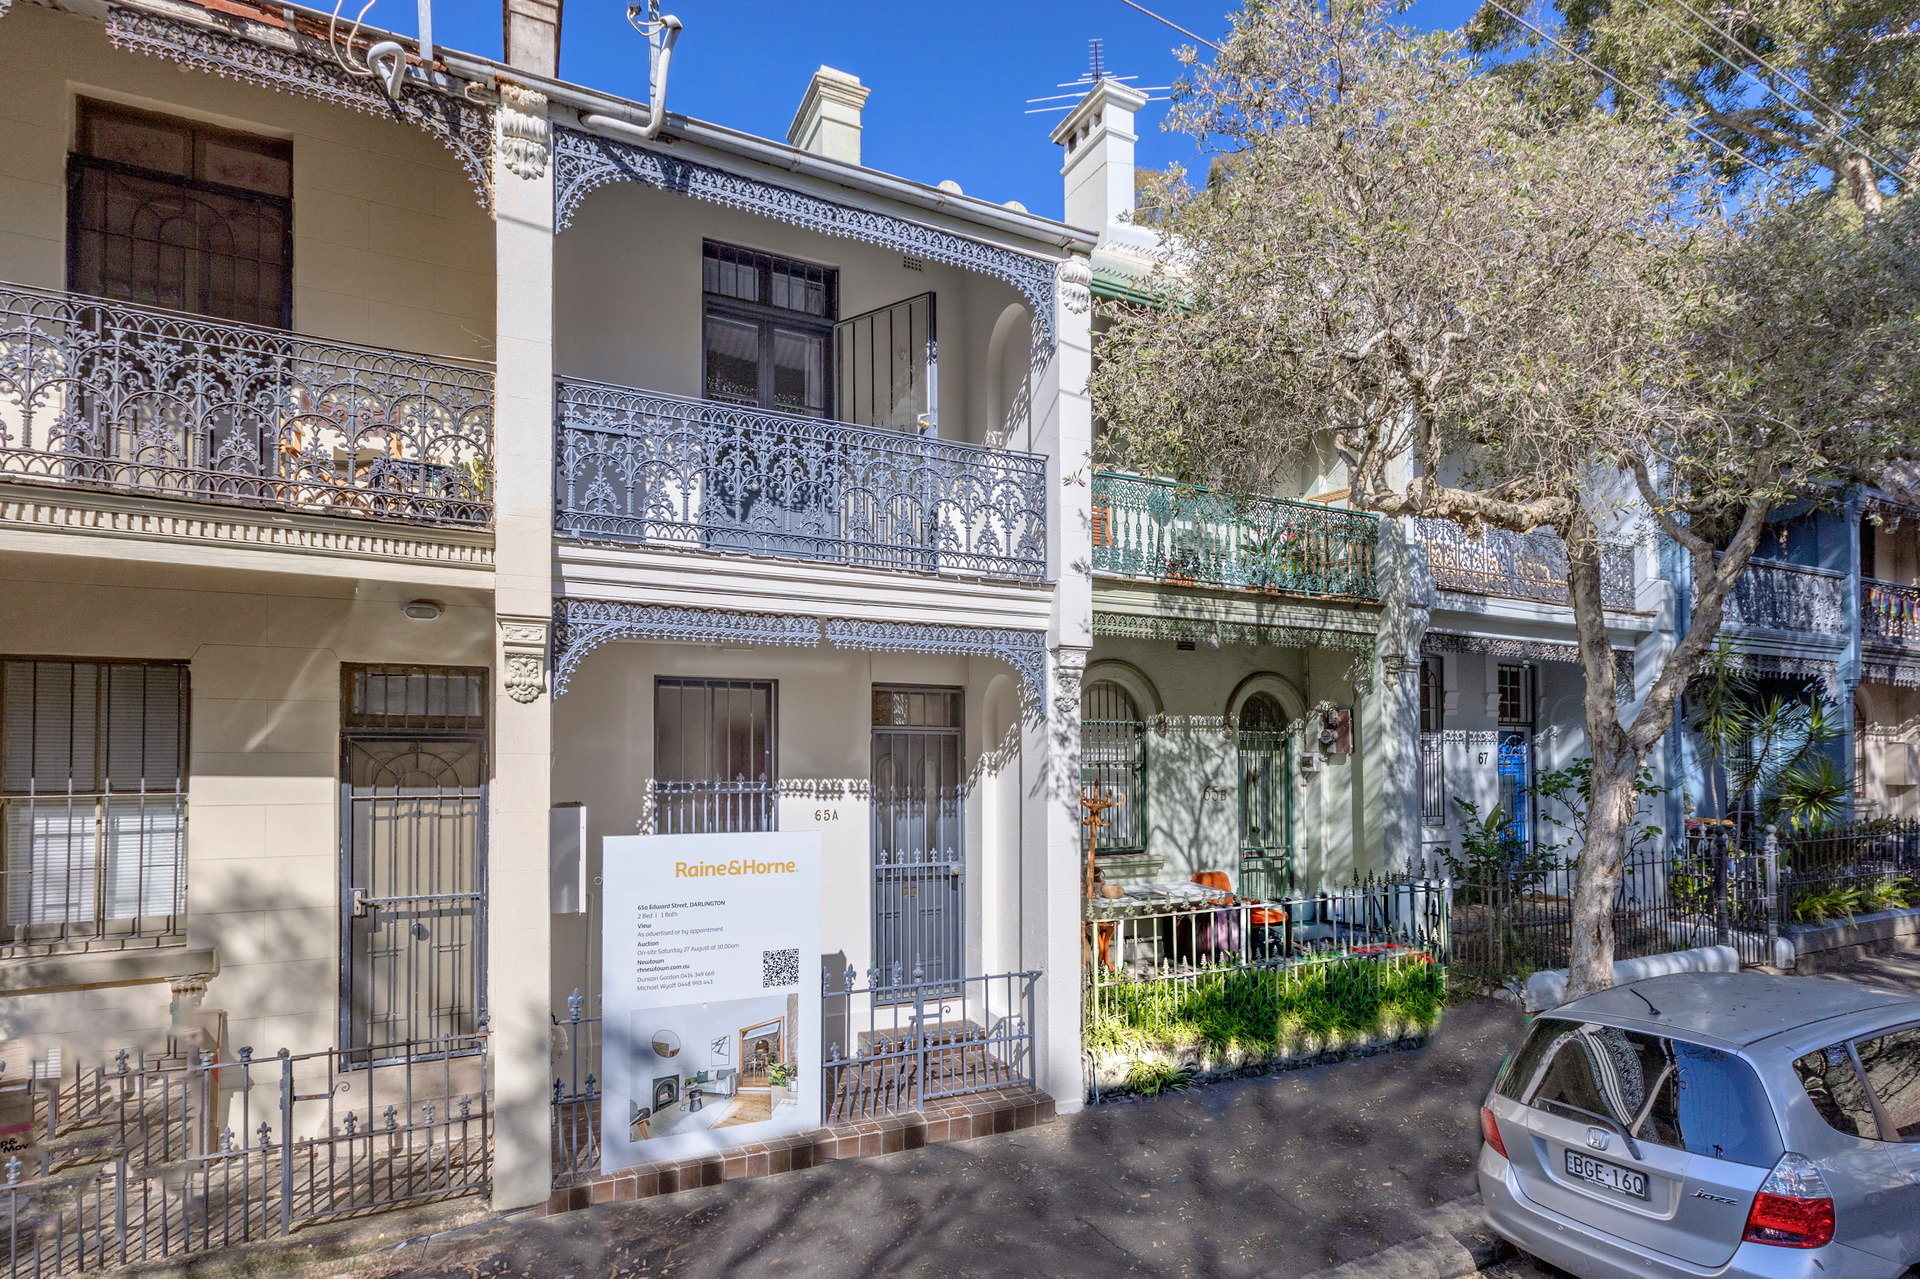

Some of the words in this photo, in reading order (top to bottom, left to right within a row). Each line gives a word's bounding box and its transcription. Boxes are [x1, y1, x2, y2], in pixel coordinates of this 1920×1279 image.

[1478, 752, 1489, 765] 67
[1204, 785, 1227, 801] 65B
[814, 809, 839, 821] 65A
[675, 859, 796, 878] Raine&Horne
[689, 900, 726, 908] DARLINGTON
[645, 929, 674, 937] advertised
[689, 926, 724, 935] appointment
[657, 947, 683, 955] Saturday
[690, 945, 710, 953] August
[637, 958, 665, 966] Newtown
[637, 964, 690, 973] rhnewtown.com.au
[659, 982, 677, 990] Wyatt
